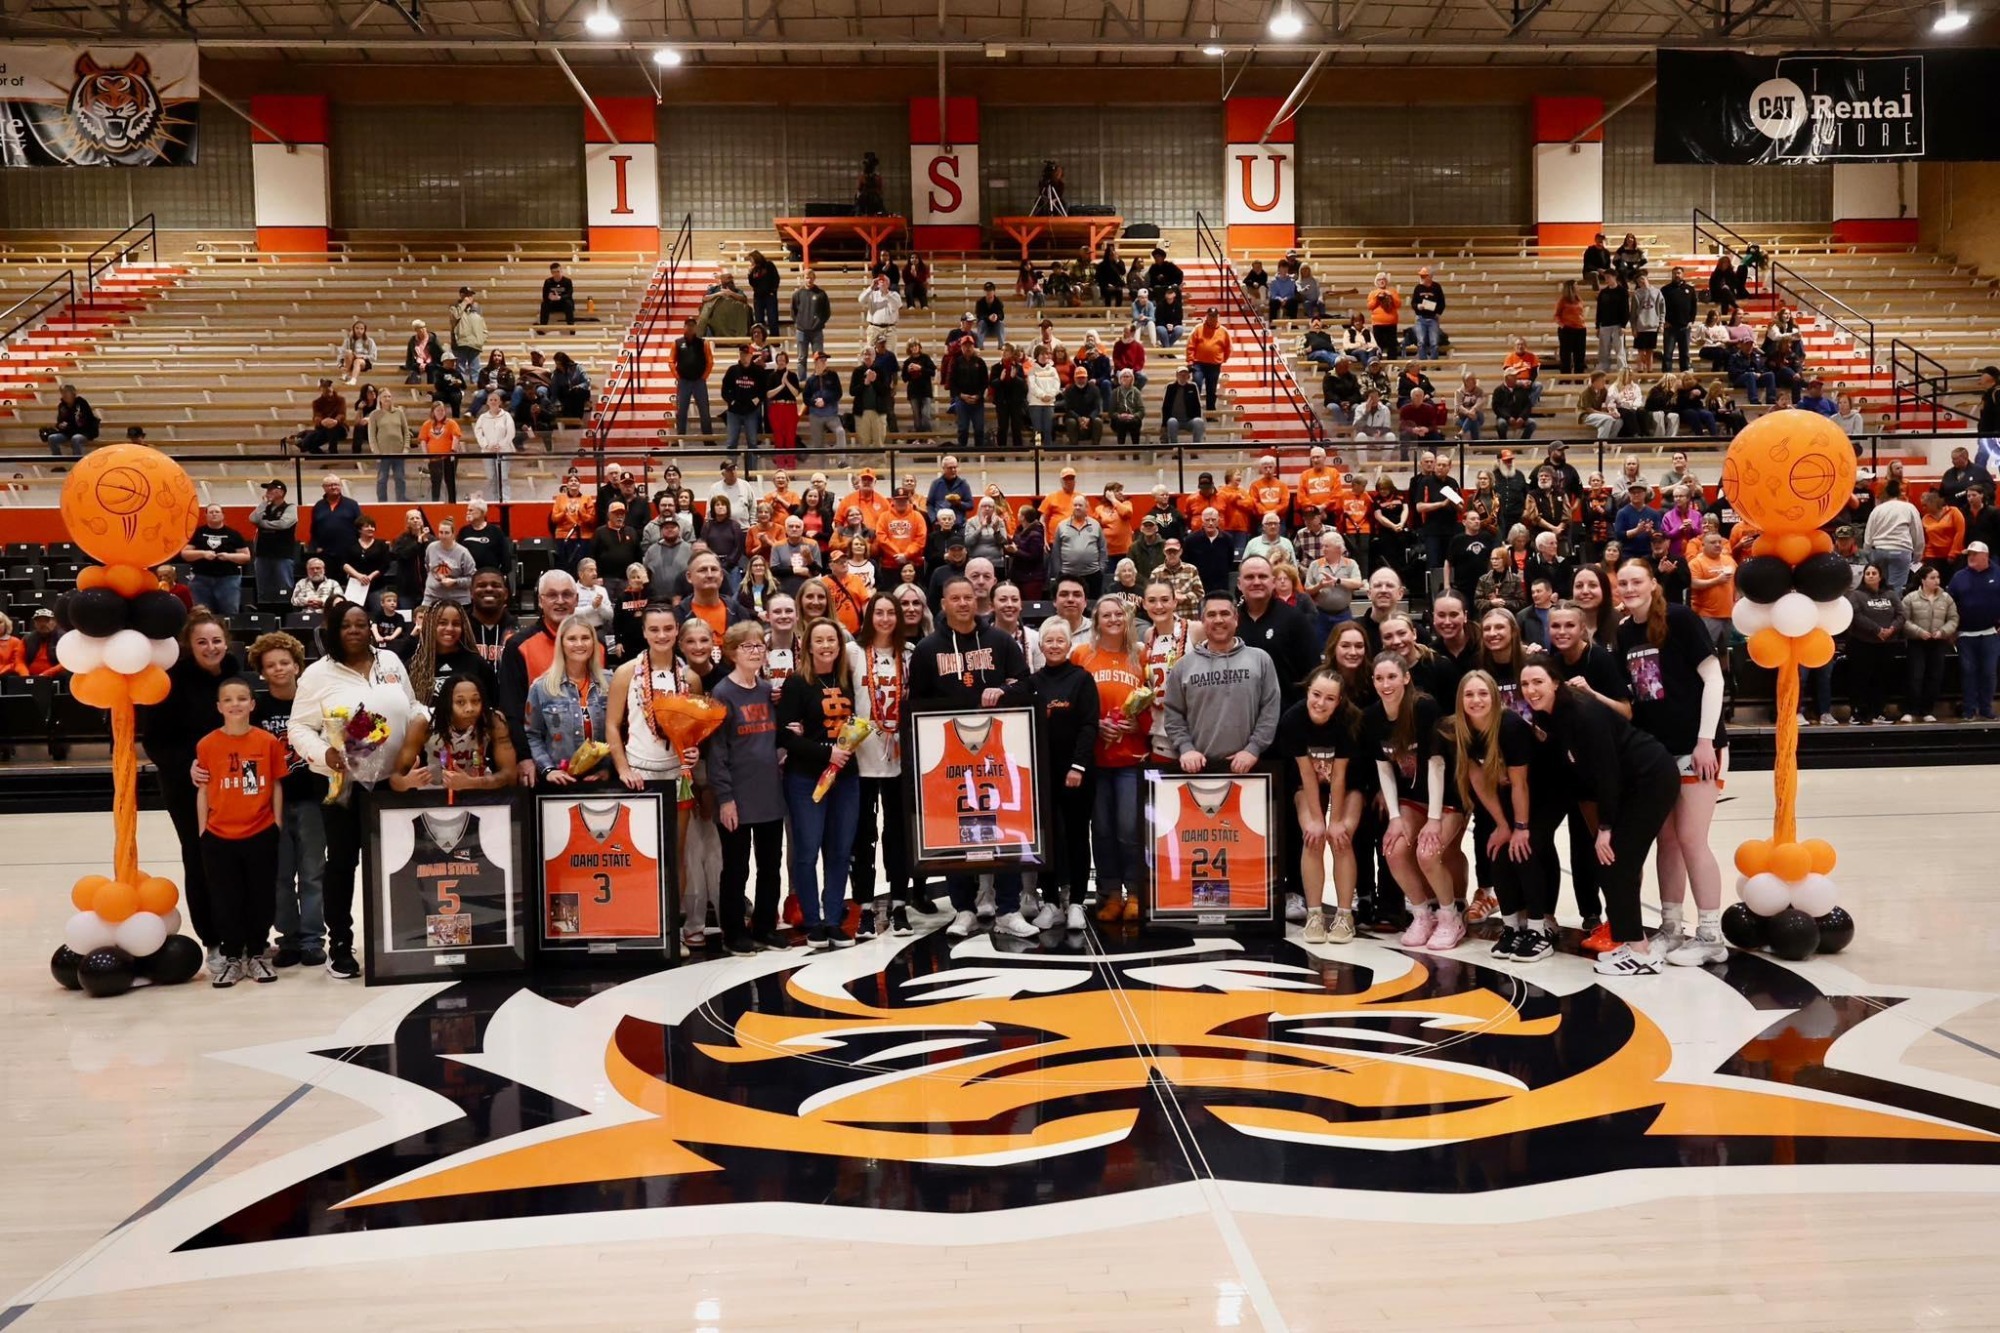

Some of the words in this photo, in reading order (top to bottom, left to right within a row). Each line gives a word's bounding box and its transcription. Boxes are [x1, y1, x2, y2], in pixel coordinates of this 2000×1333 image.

[11, 76, 24, 86] of
[1811, 67, 1912, 92] THE
[1758, 96, 1796, 120] CAT
[1811, 93, 1913, 120] Rental
[1811, 121, 1912, 147] STORE
[608, 155, 634, 214] I
[928, 155, 963, 214] S
[1235, 154, 1288, 213] U
[936, 653, 965, 676] IDAHO
[965, 647, 996, 671] STATE
[1113, 670, 1141, 689] STATE
[1190, 670, 1222, 686] IDAHO
[1222, 668, 1250, 680] STATE
[1197, 678, 1242, 688] UNIVERSITY
[946, 764, 974, 779] IDAHO
[976, 763, 1005, 778] STATE
[1181, 828, 1209, 843] IDAHO
[1211, 828, 1240, 843] STATE
[447, 862, 480, 876] STATE
[570, 853, 599, 868] IDAHO
[601, 853, 632, 868] STATE
[1191, 847, 1228, 878] 24
[437, 879, 461, 915] 5
[593, 872, 612, 904] 3
